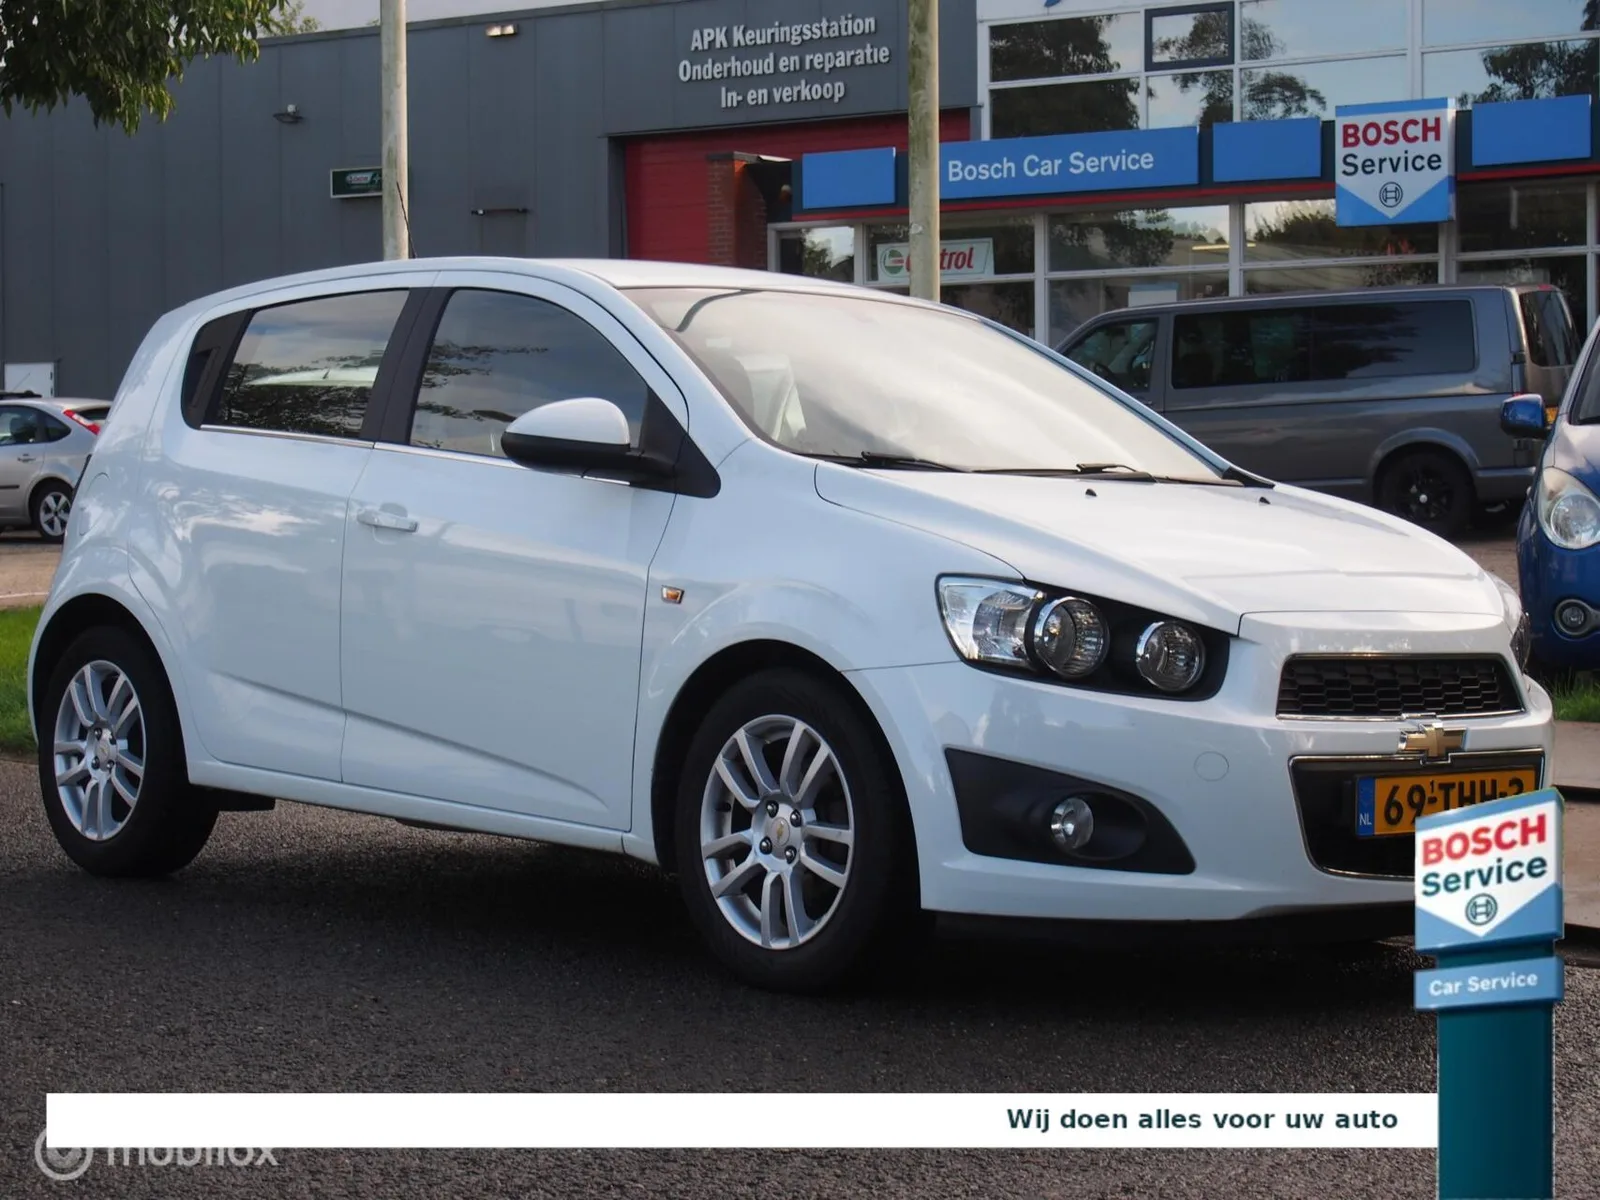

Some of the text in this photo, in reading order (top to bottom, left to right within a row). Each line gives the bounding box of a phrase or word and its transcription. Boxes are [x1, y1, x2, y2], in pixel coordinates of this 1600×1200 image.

[691, 14, 875, 51] APK Keuringsstation
[679, 43, 889, 82] Onderhoud en reparatie
[721, 79, 845, 108] In- en verkoop
[1342, 116, 1441, 148] BOSCH
[948, 149, 1154, 182] Bosch Car Service
[1342, 149, 1442, 177] Service
[1359, 813, 1372, 826] NL
